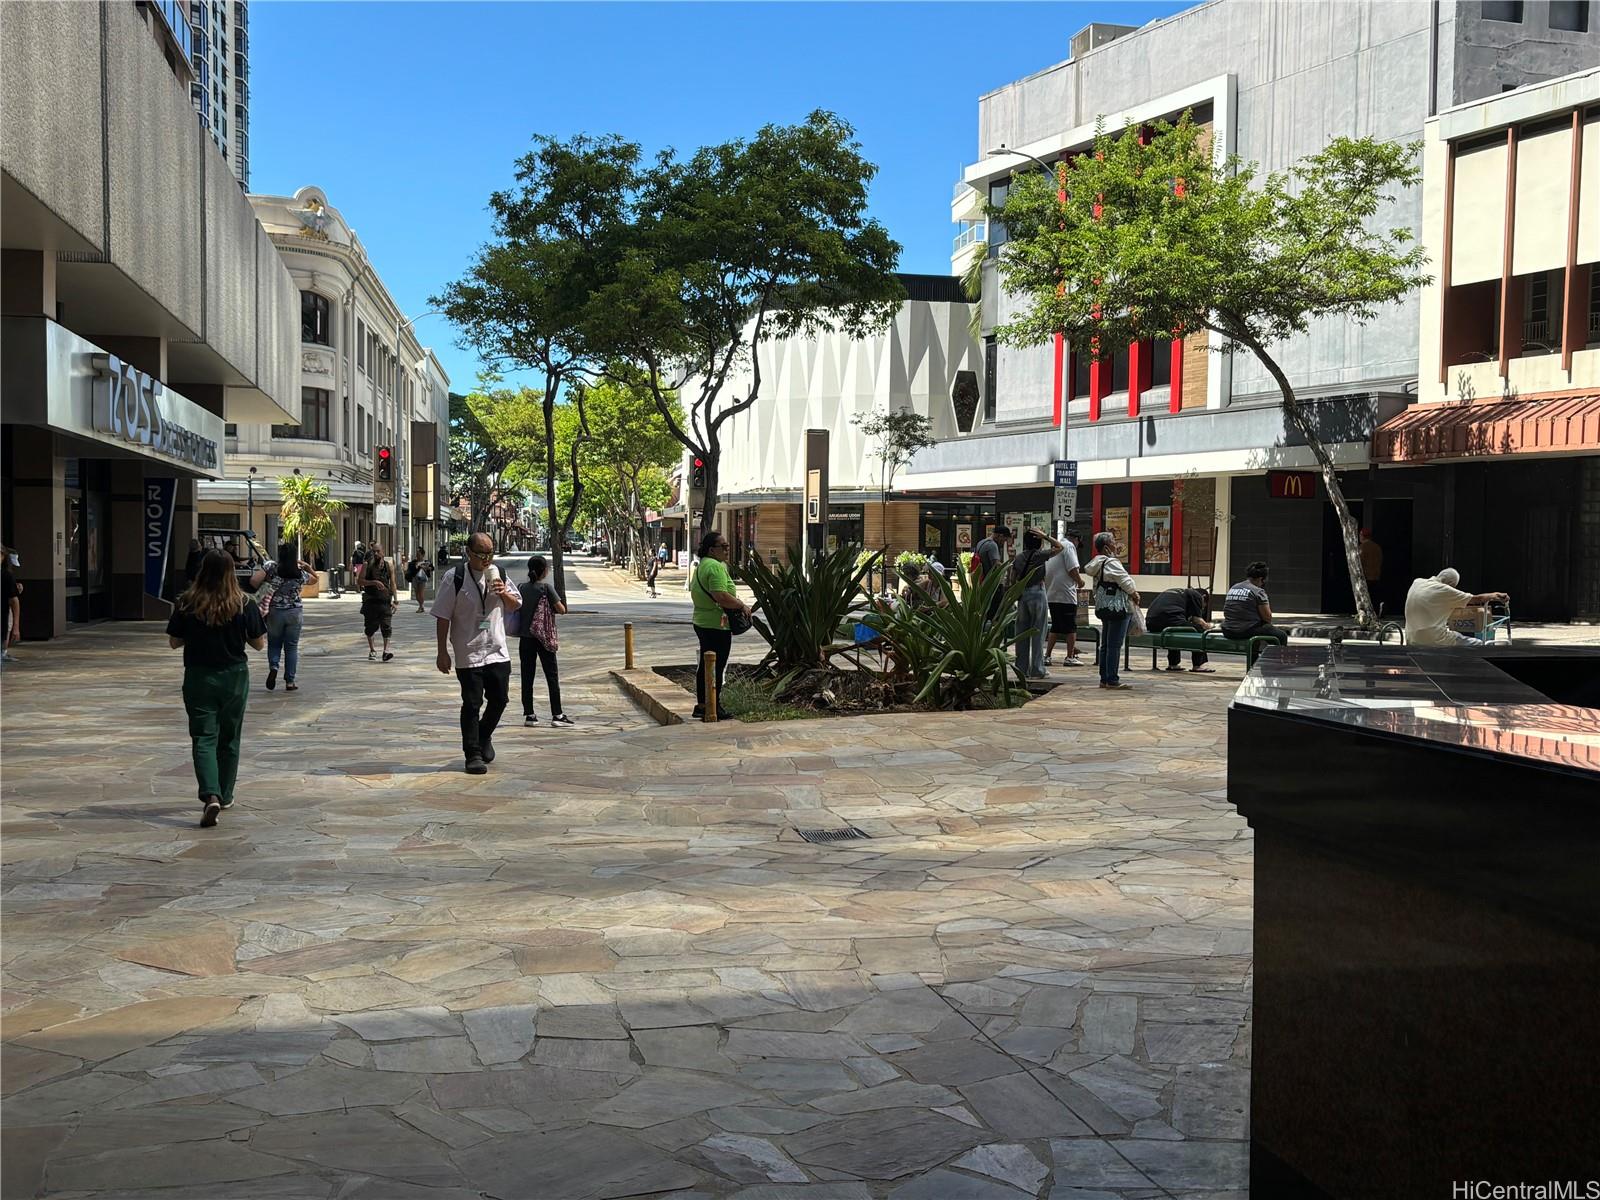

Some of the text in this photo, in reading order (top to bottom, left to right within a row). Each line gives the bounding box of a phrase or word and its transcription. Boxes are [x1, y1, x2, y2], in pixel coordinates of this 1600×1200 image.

[102, 353, 163, 450] ROSS
[147, 485, 163, 557] ROSS
[1058, 505, 1072, 518] 15
